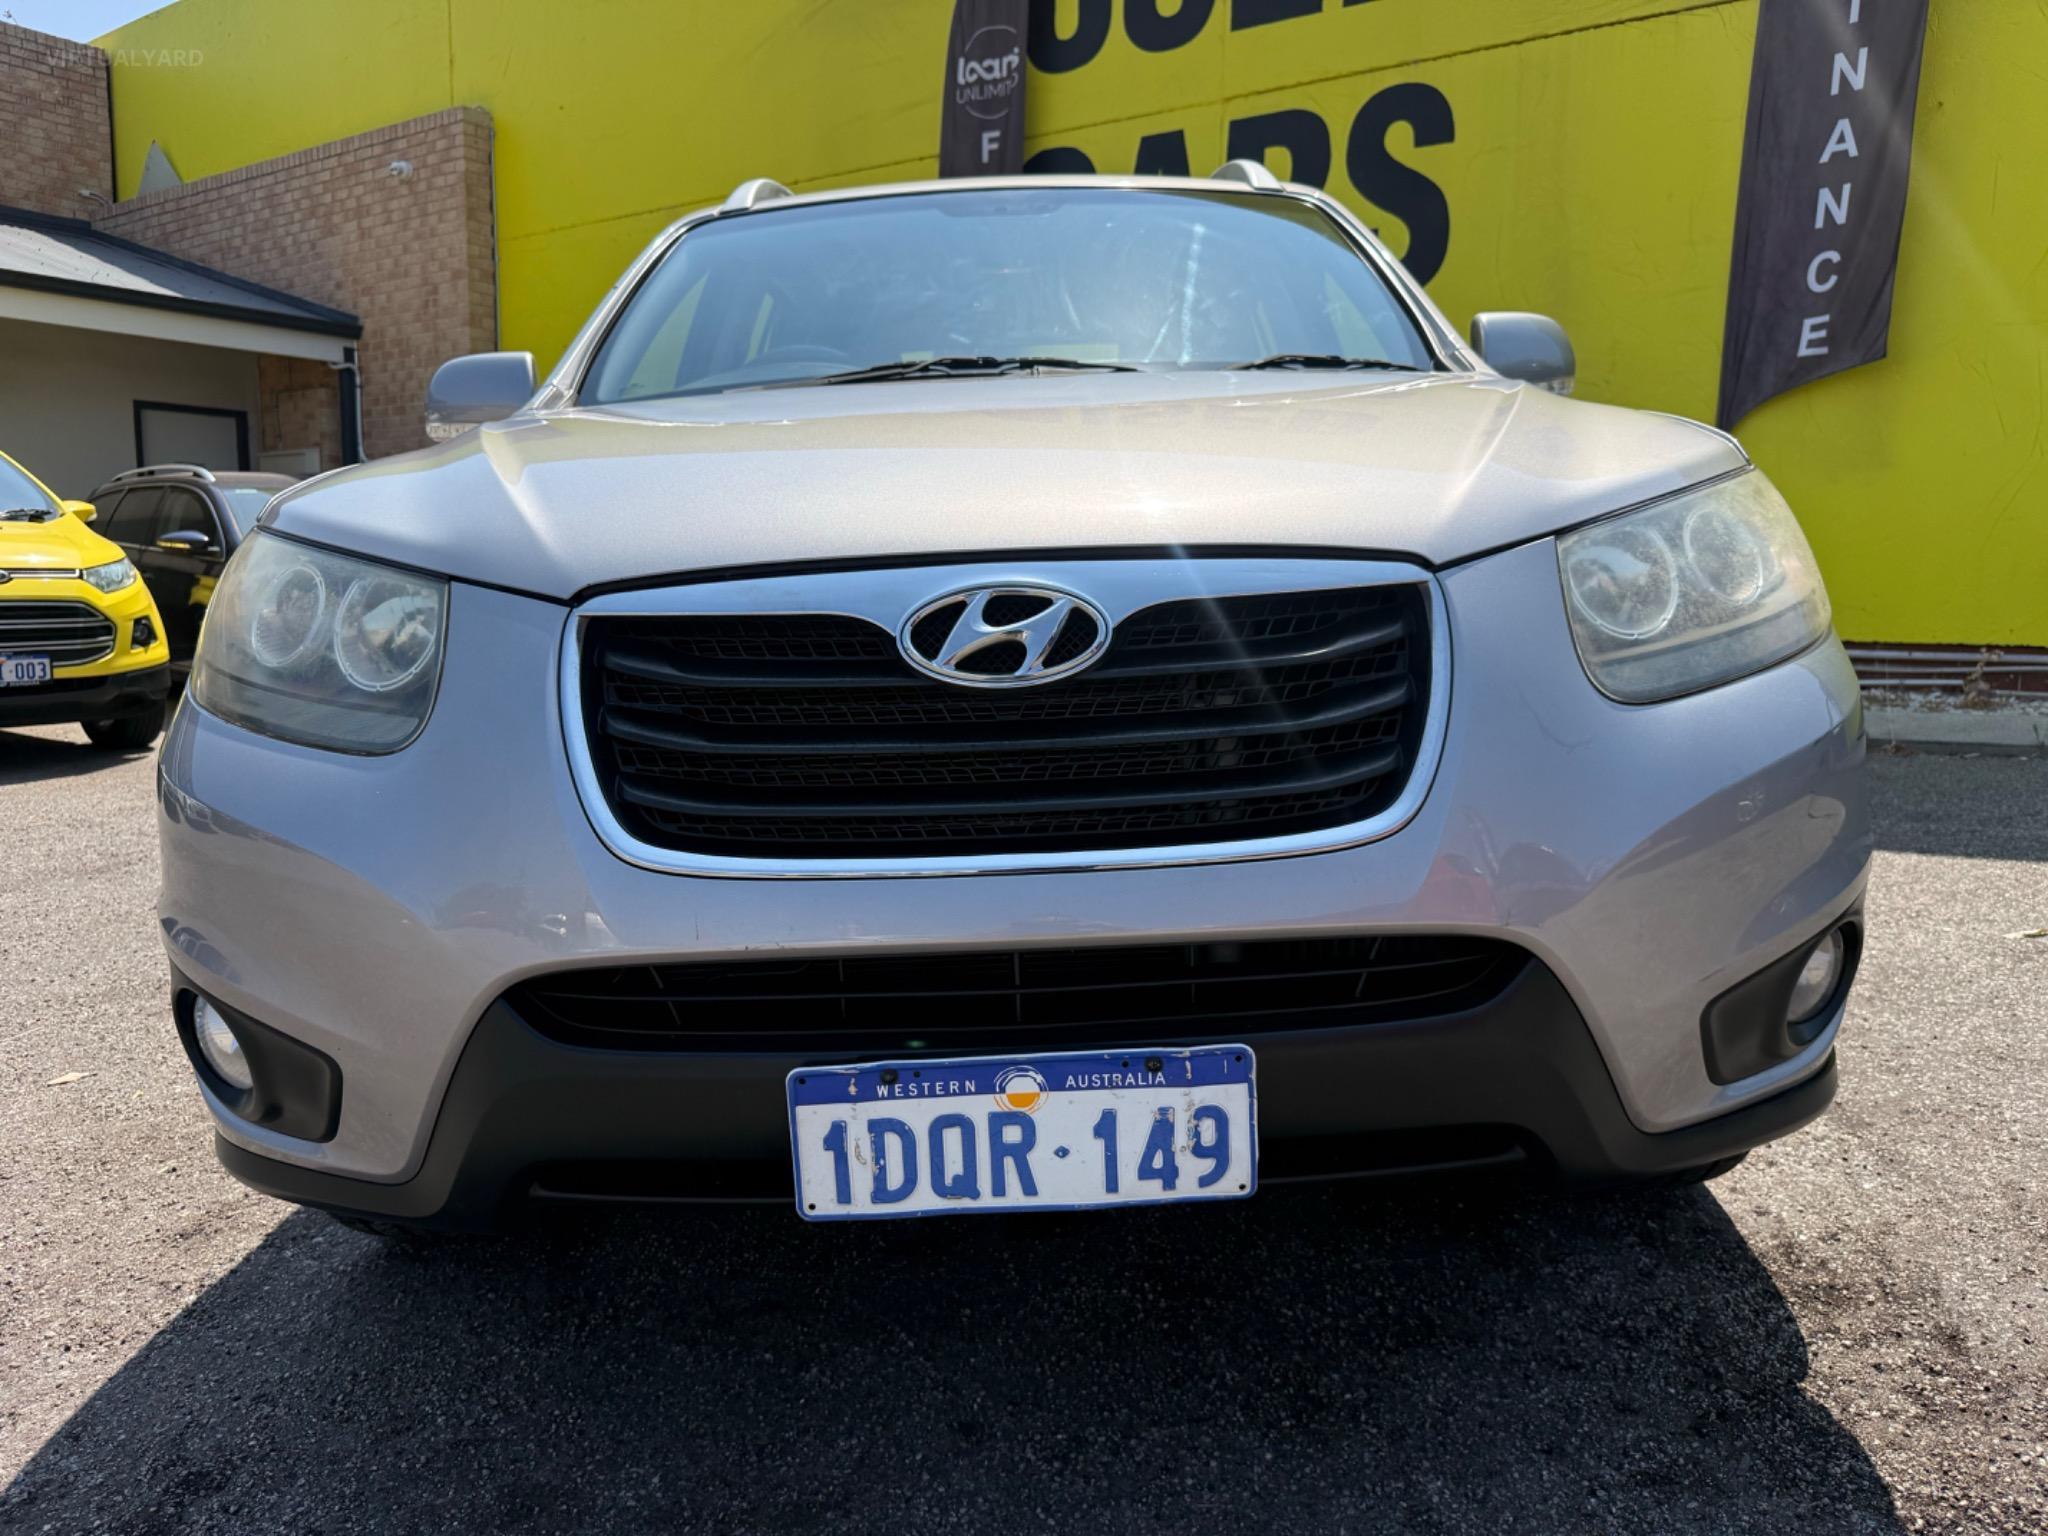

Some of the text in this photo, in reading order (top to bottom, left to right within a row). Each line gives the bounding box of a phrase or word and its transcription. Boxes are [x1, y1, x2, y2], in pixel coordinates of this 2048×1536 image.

[981, 130, 1001, 164] F
[876, 1071, 1166, 1098] WESTERN AUSTRALIA
